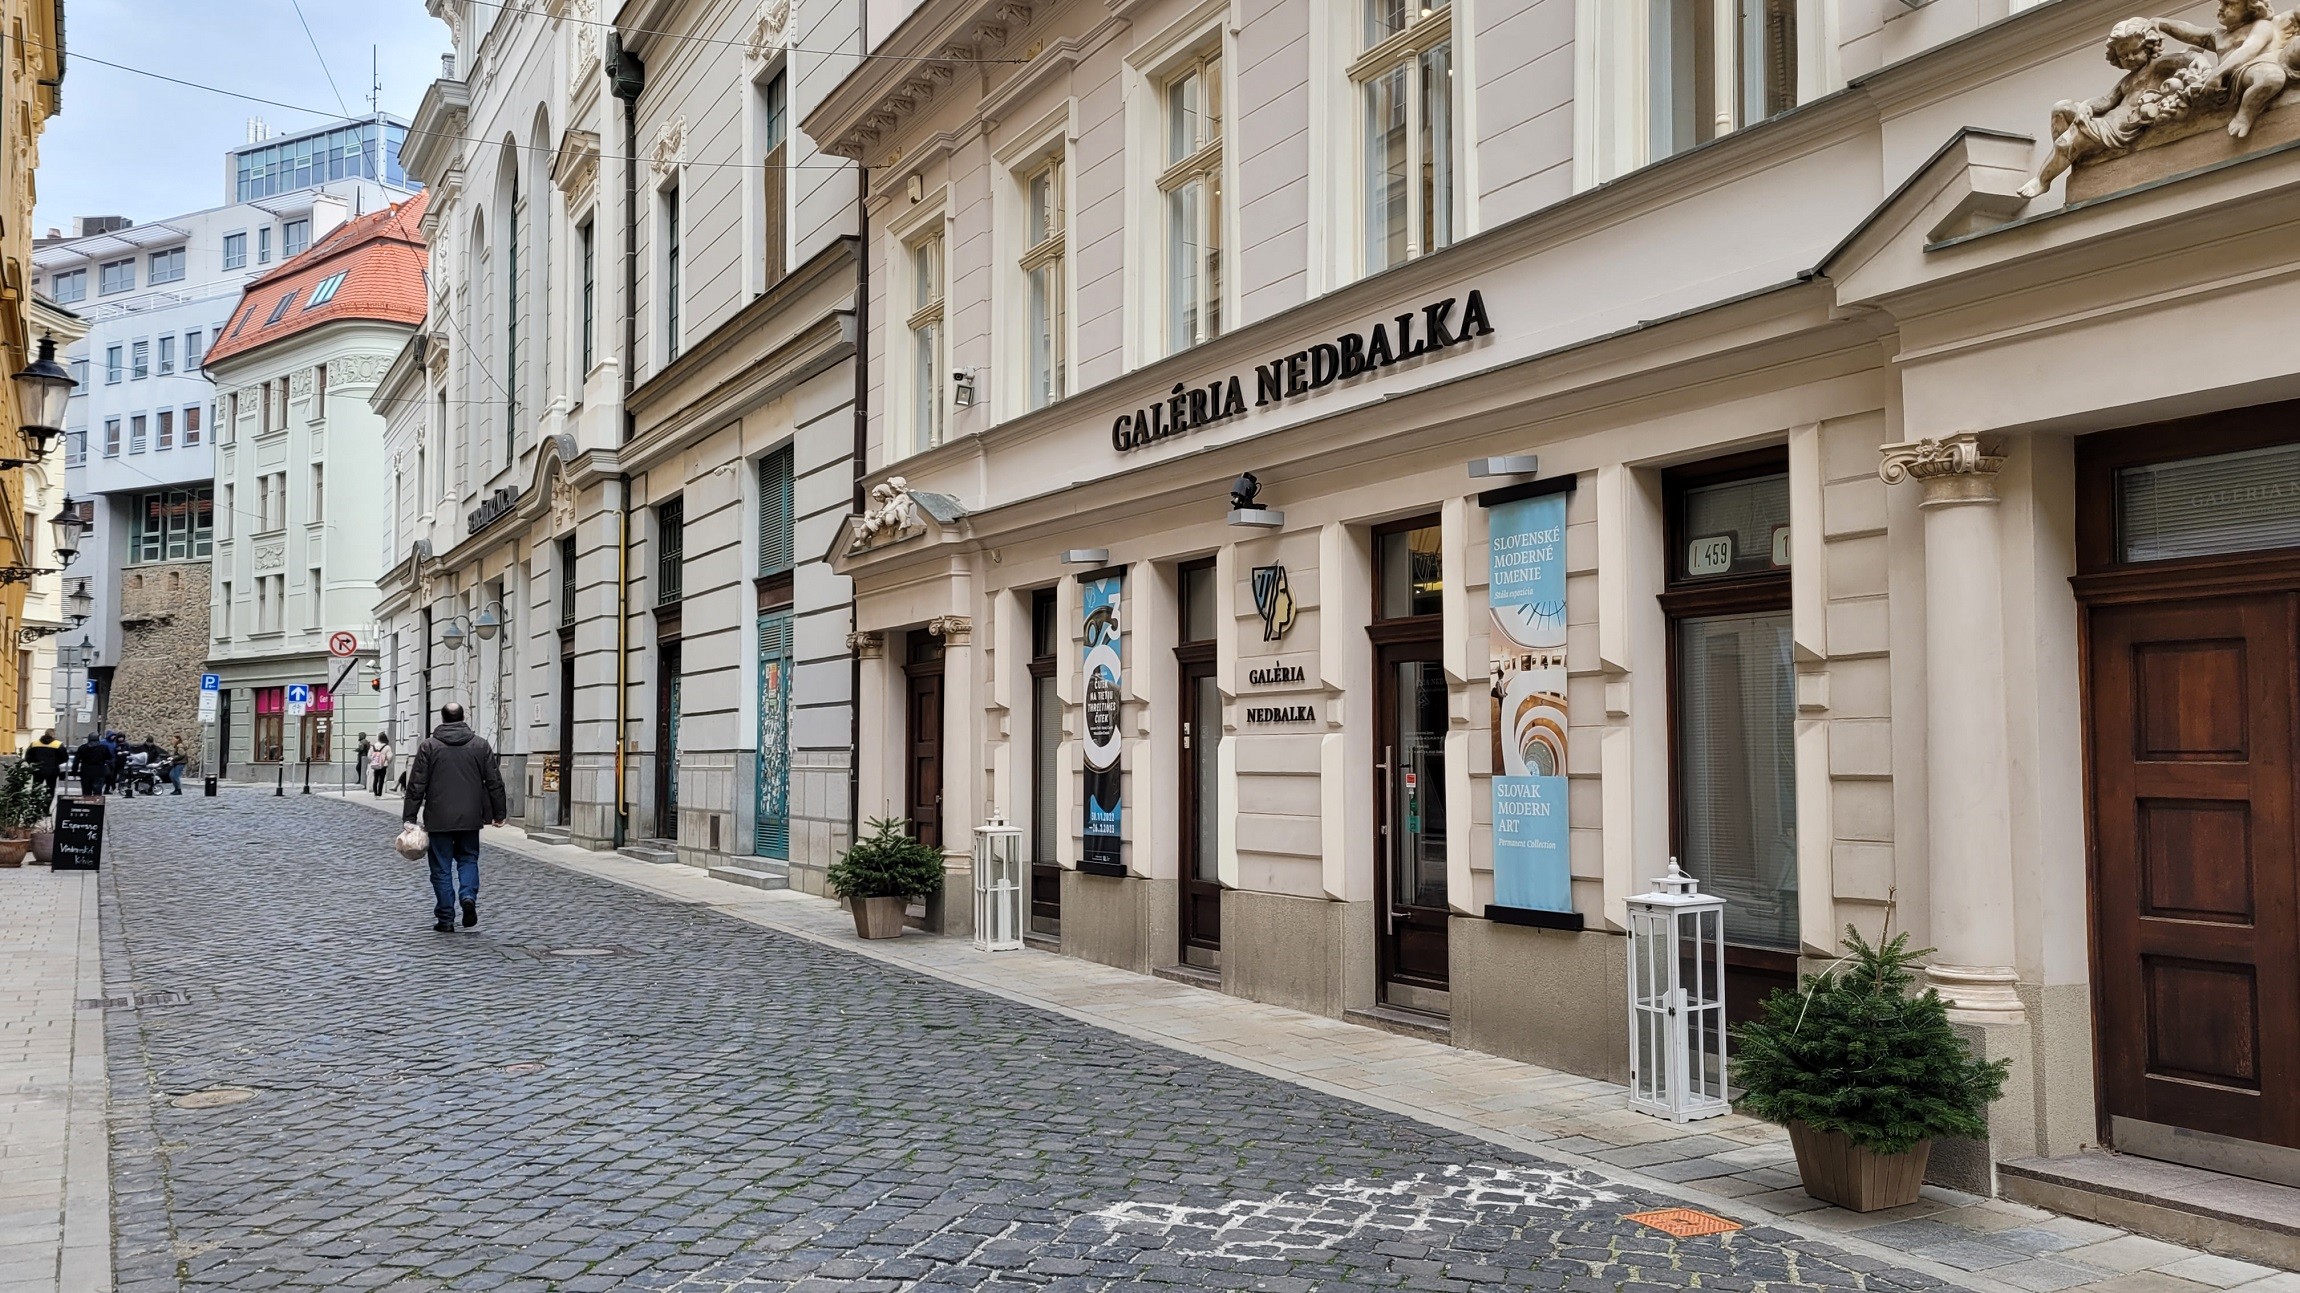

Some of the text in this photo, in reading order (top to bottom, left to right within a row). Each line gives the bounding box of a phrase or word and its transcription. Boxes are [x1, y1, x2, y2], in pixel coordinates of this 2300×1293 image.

[1111, 289, 1495, 452] GALÉRIA NEDBALKA
[1493, 525, 1560, 551] SLOVENSKÉ
[1493, 544, 1554, 569] MODERNÉ
[1704, 542, 1728, 566] 459
[1494, 566, 1542, 586] UMENIE
[1494, 589, 1508, 600] Stála
[1249, 660, 1305, 685] GALÉRIA
[204, 676, 216, 689] P
[1246, 705, 1316, 723] NEDBALKA
[1497, 784, 1541, 798] SLOVAK
[1498, 801, 1551, 816] MODERN
[61, 819, 98, 833] Espresso
[1498, 819, 1520, 833] ART
[1498, 838, 1556, 850] Permanent Collection
